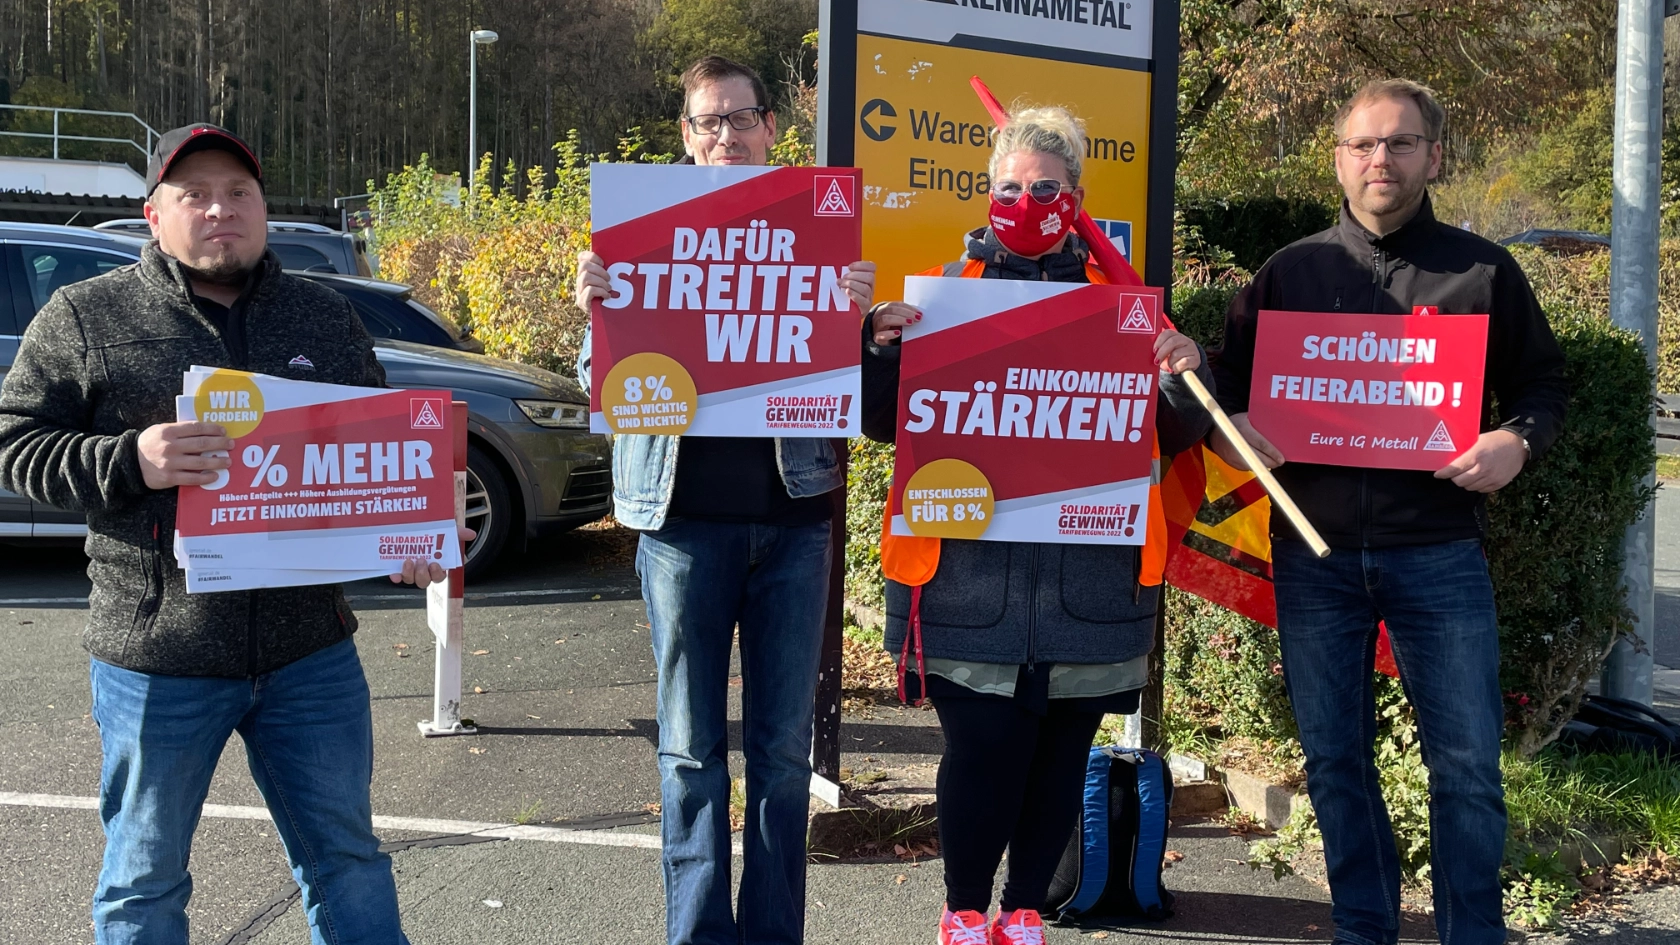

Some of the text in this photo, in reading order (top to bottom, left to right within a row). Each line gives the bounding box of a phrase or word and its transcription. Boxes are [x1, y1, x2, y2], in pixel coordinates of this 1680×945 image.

[959, 0, 1132, 30] NAMETAL
[672, 219, 796, 262] DAFÜR
[601, 262, 850, 312] STREITEN
[704, 313, 813, 363] WIR
[1302, 331, 1437, 364] SCHÖNEN
[1005, 367, 1153, 396] EINKOMMEN
[1270, 374, 1445, 408] FEIERABEND
[209, 390, 250, 409] WIR
[612, 401, 688, 417] SIND WICHTIG
[766, 394, 838, 407] SOLIDARITÄT
[203, 410, 258, 423] FORDERN
[617, 414, 688, 429] UND RICHTIG
[904, 380, 1149, 444] STÄRKEN!
[1309, 433, 1419, 450] Eure IG Metall
[302, 440, 434, 485] MEHR
[219, 492, 249, 503] Höhere
[250, 491, 283, 502] Entgelte
[300, 488, 326, 498] Höhere
[326, 485, 417, 499] Ausbildungsvergütungen
[908, 487, 988, 500] ENTSCHLOSSEN
[210, 496, 427, 526] JETZT EINKOMMEN STÄRKEN!
[911, 501, 949, 523] FÜR
[1060, 503, 1127, 516] SOLIDARITÄT
[379, 534, 435, 544] SOLIDARITÄT
[1058, 528, 1106, 536] TARIFBEWEGUNG
